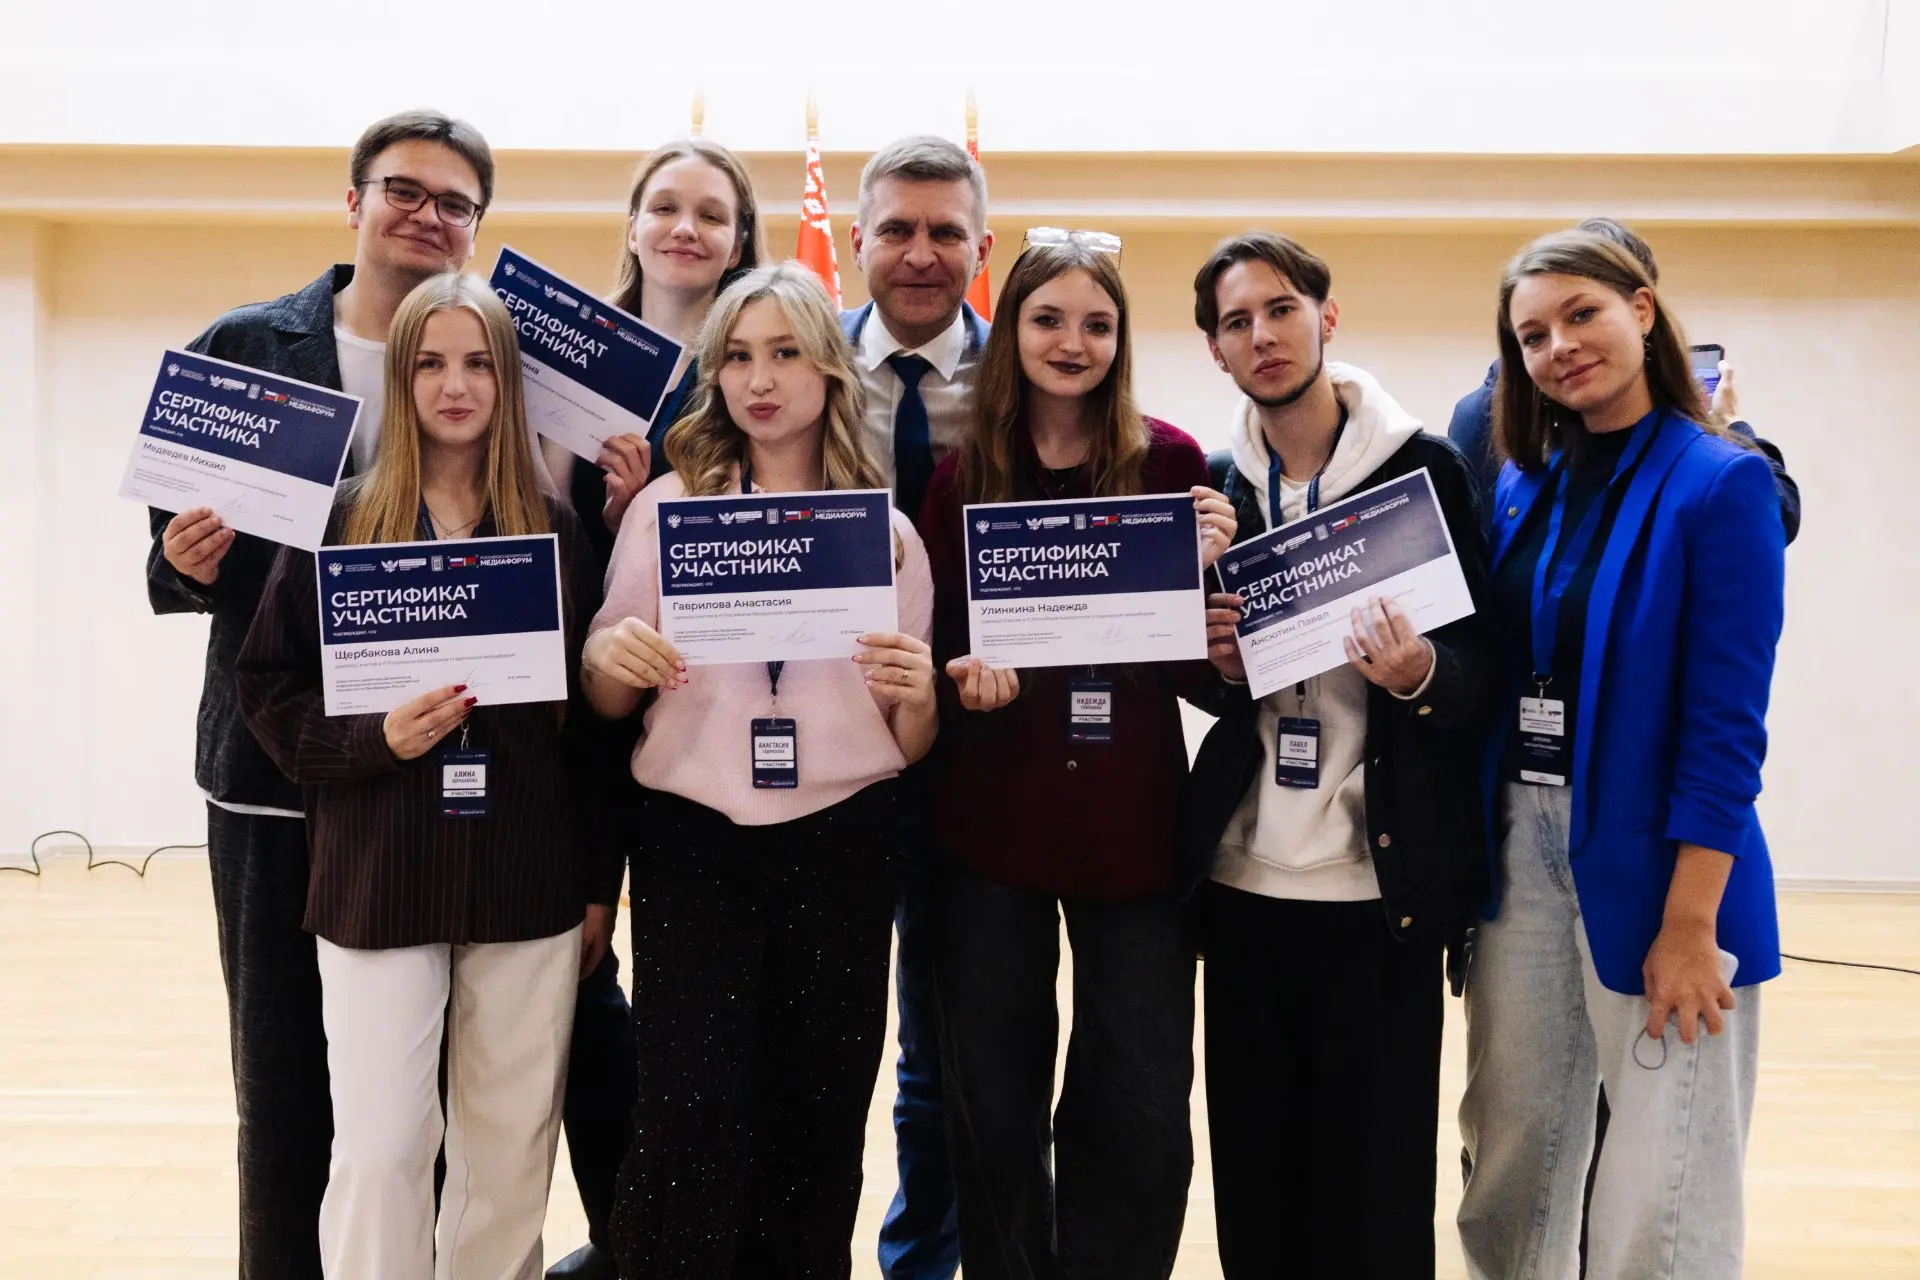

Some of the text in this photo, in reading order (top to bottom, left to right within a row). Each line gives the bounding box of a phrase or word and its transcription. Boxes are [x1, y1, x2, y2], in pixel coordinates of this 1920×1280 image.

[511, 313, 587, 369] АСТНИКА
[158, 390, 280, 434] СЕРТИФИКАТ
[153, 406, 260, 448] УЧАСТНИКА
[143, 442, 226, 471] Медведев Михаил
[815, 511, 867, 520] МЕДИАФОРУМ
[1121, 516, 1174, 525] МЕДИАФОРУМ
[669, 537, 815, 559] СЕРТИФИКАТ
[978, 542, 1121, 565] СЕРТИФИКАТ
[480, 557, 533, 566] МЕДИАФОРУМ
[670, 556, 802, 579] УЧАСТНИКА
[979, 561, 1109, 583] УЧАСТНИКА
[1236, 538, 1366, 600] СЕРТИФИКАТ
[331, 584, 480, 608] СЕРТИФИКАТ
[1240, 561, 1362, 619] УЧАСТНИКА
[331, 603, 468, 627] УЧАСТНИКА
[672, 598, 792, 612] Гаврилова Анастасия
[981, 603, 1088, 615] Улинкина Надежда
[1251, 625, 1296, 647] Ансютин
[1297, 611, 1330, 629] Павел
[334, 648, 400, 661] Щербакова
[403, 646, 440, 656] Алина
[454, 770, 476, 778] АЛИНА
